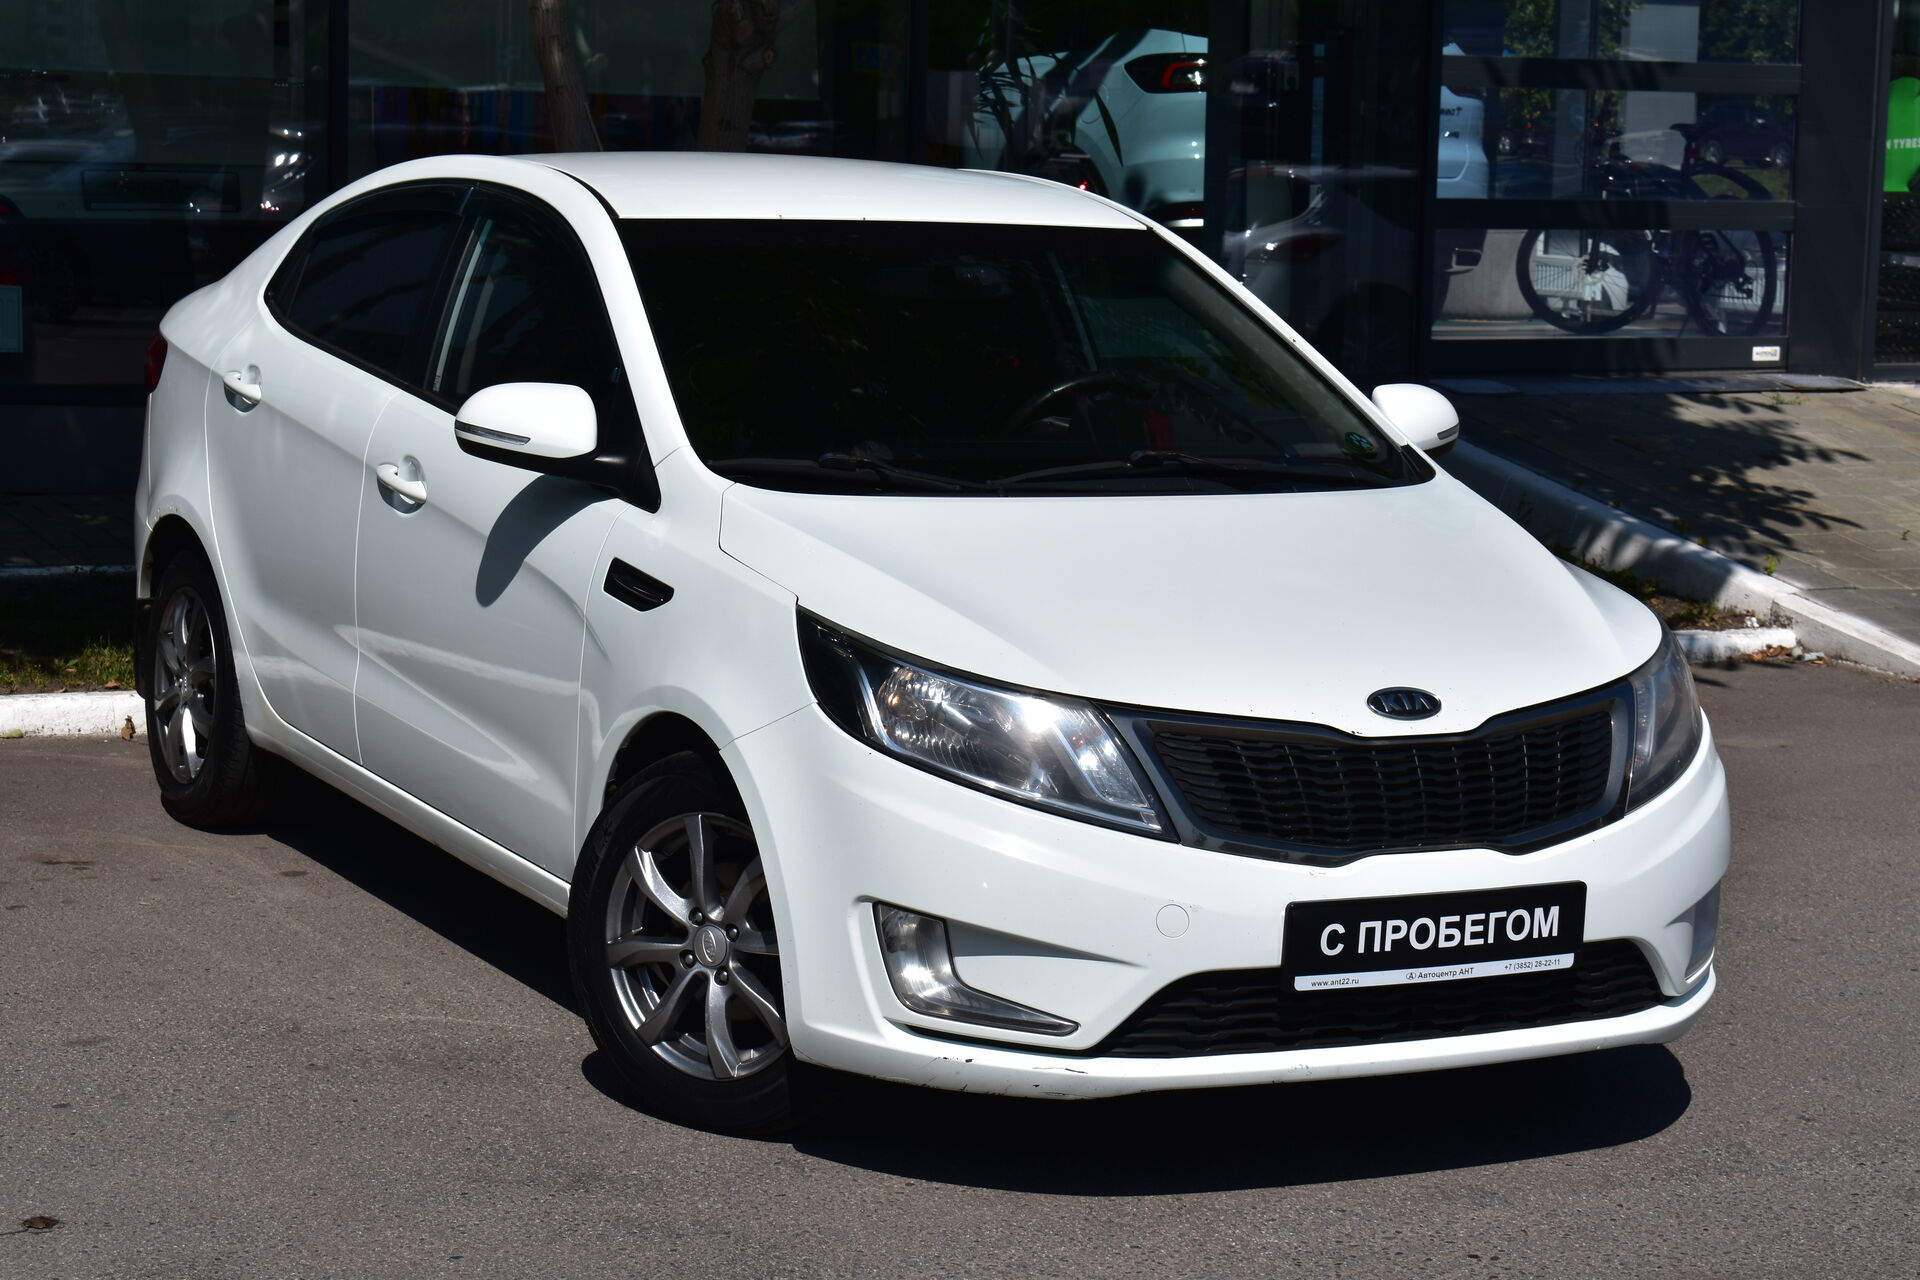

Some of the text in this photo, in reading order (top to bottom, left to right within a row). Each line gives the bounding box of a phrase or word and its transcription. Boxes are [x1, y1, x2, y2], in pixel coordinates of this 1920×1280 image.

[1378, 692, 1433, 712] KIA
[1320, 906, 1559, 956] С ПРОБЕГОМ
[1513, 961, 1533, 970] (3852)
[1534, 959, 1561, 968] 28-22-11
[1417, 969, 1457, 980] Автоцентр
[1459, 967, 1474, 976] АНТ
[1311, 978, 1360, 987] www.ant22.ru
